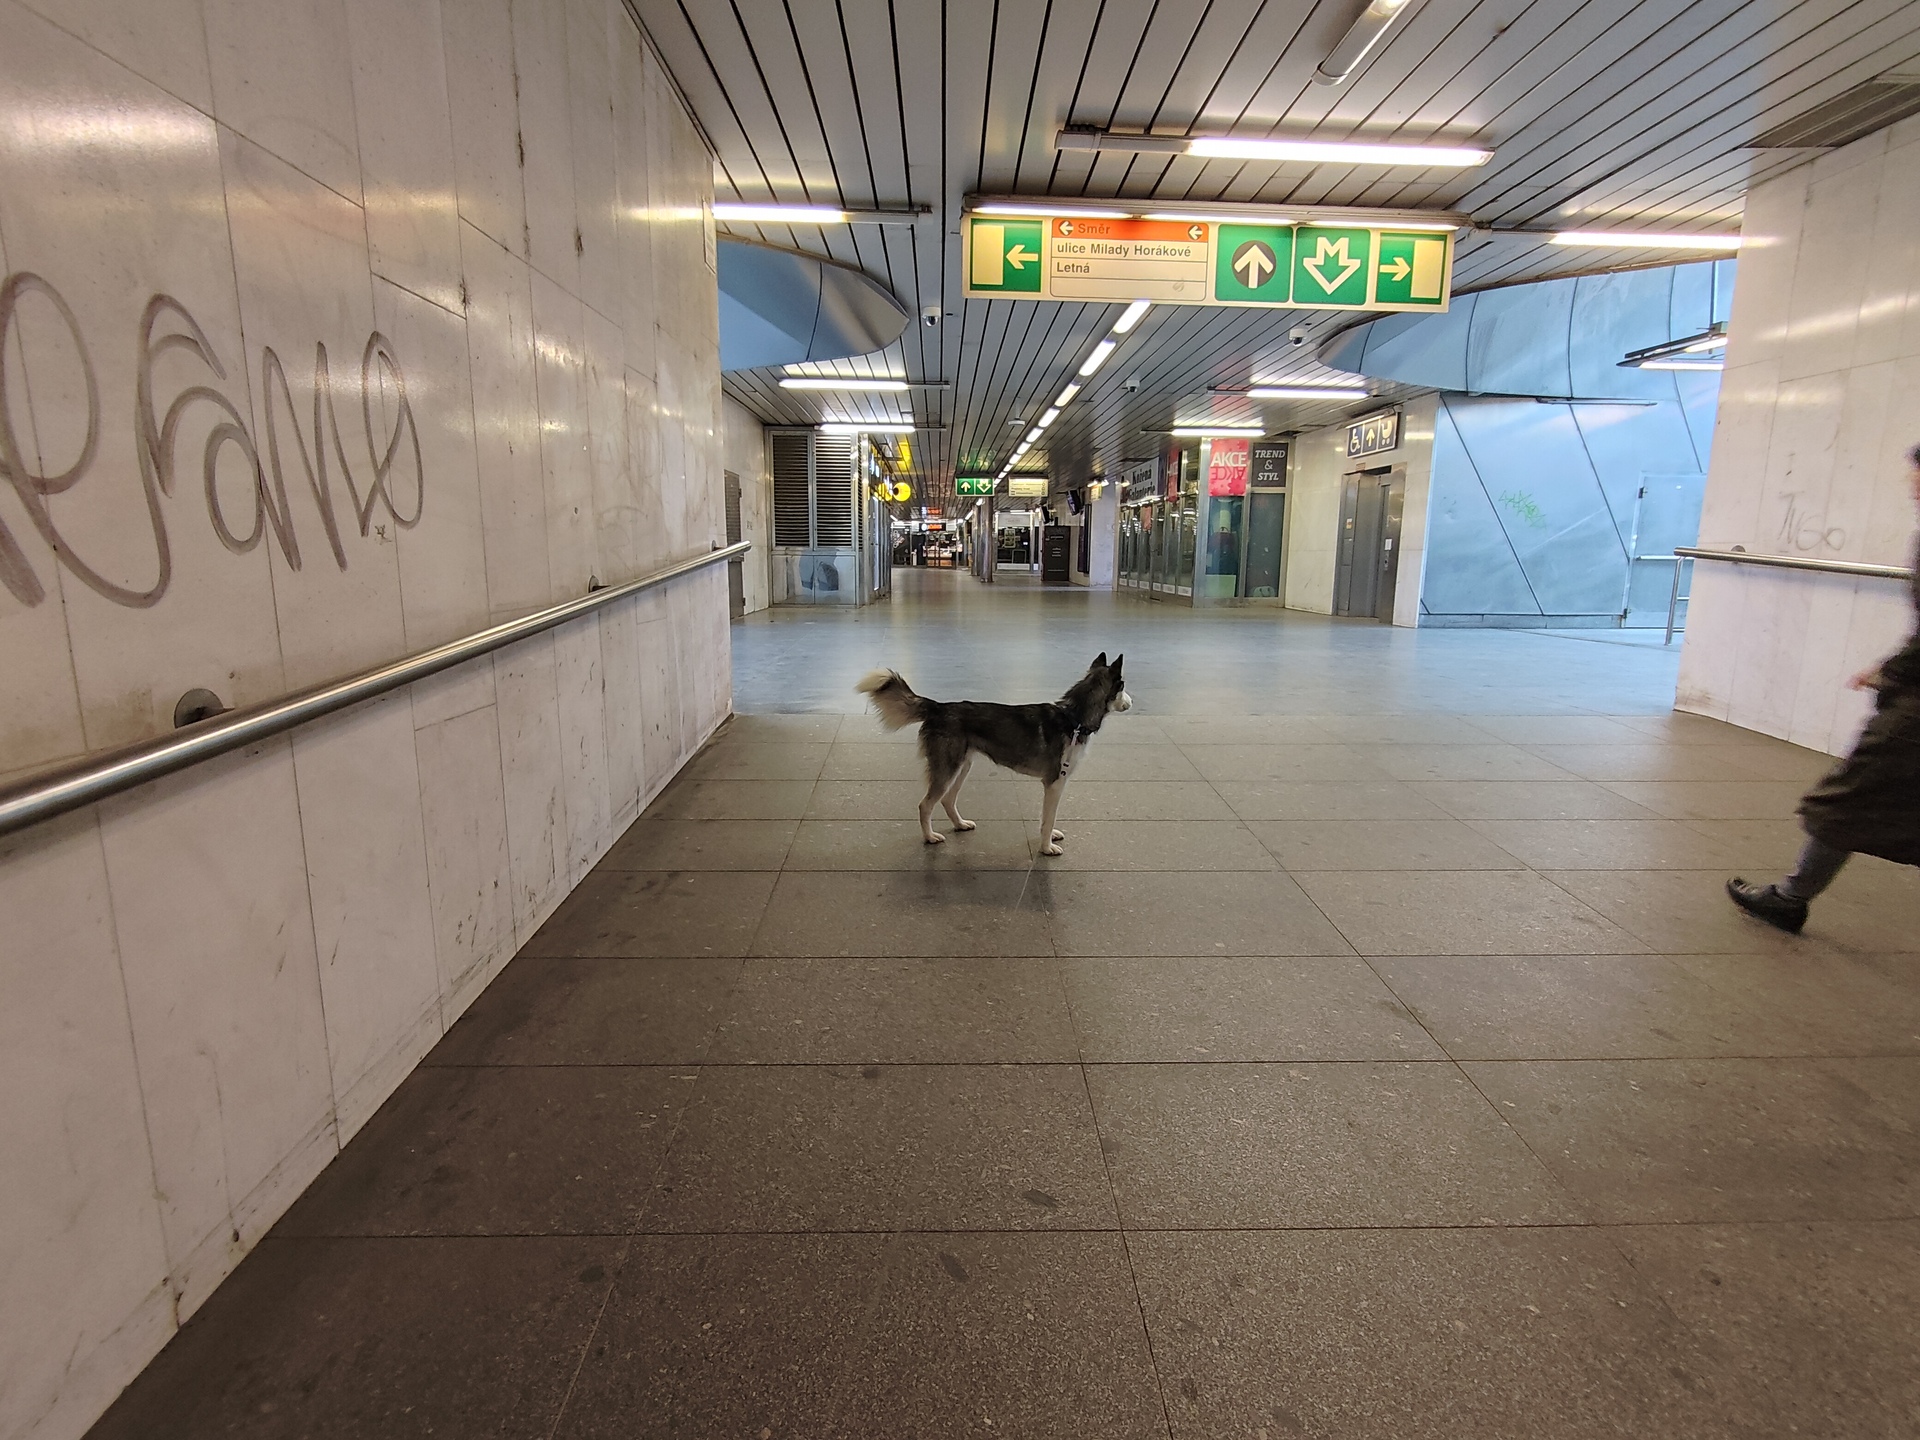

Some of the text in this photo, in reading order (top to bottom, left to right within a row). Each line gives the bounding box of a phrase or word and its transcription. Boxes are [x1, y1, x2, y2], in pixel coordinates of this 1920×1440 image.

[1078, 223, 1110, 235] Směr
[1057, 242, 1191, 257] ulice Milady Horákové
[1056, 262, 1090, 274] Letná
[1210, 452, 1247, 467] AKCE
[1255, 450, 1285, 458] TREND
[1264, 460, 1273, 470] &
[1258, 472, 1279, 481] STYL
